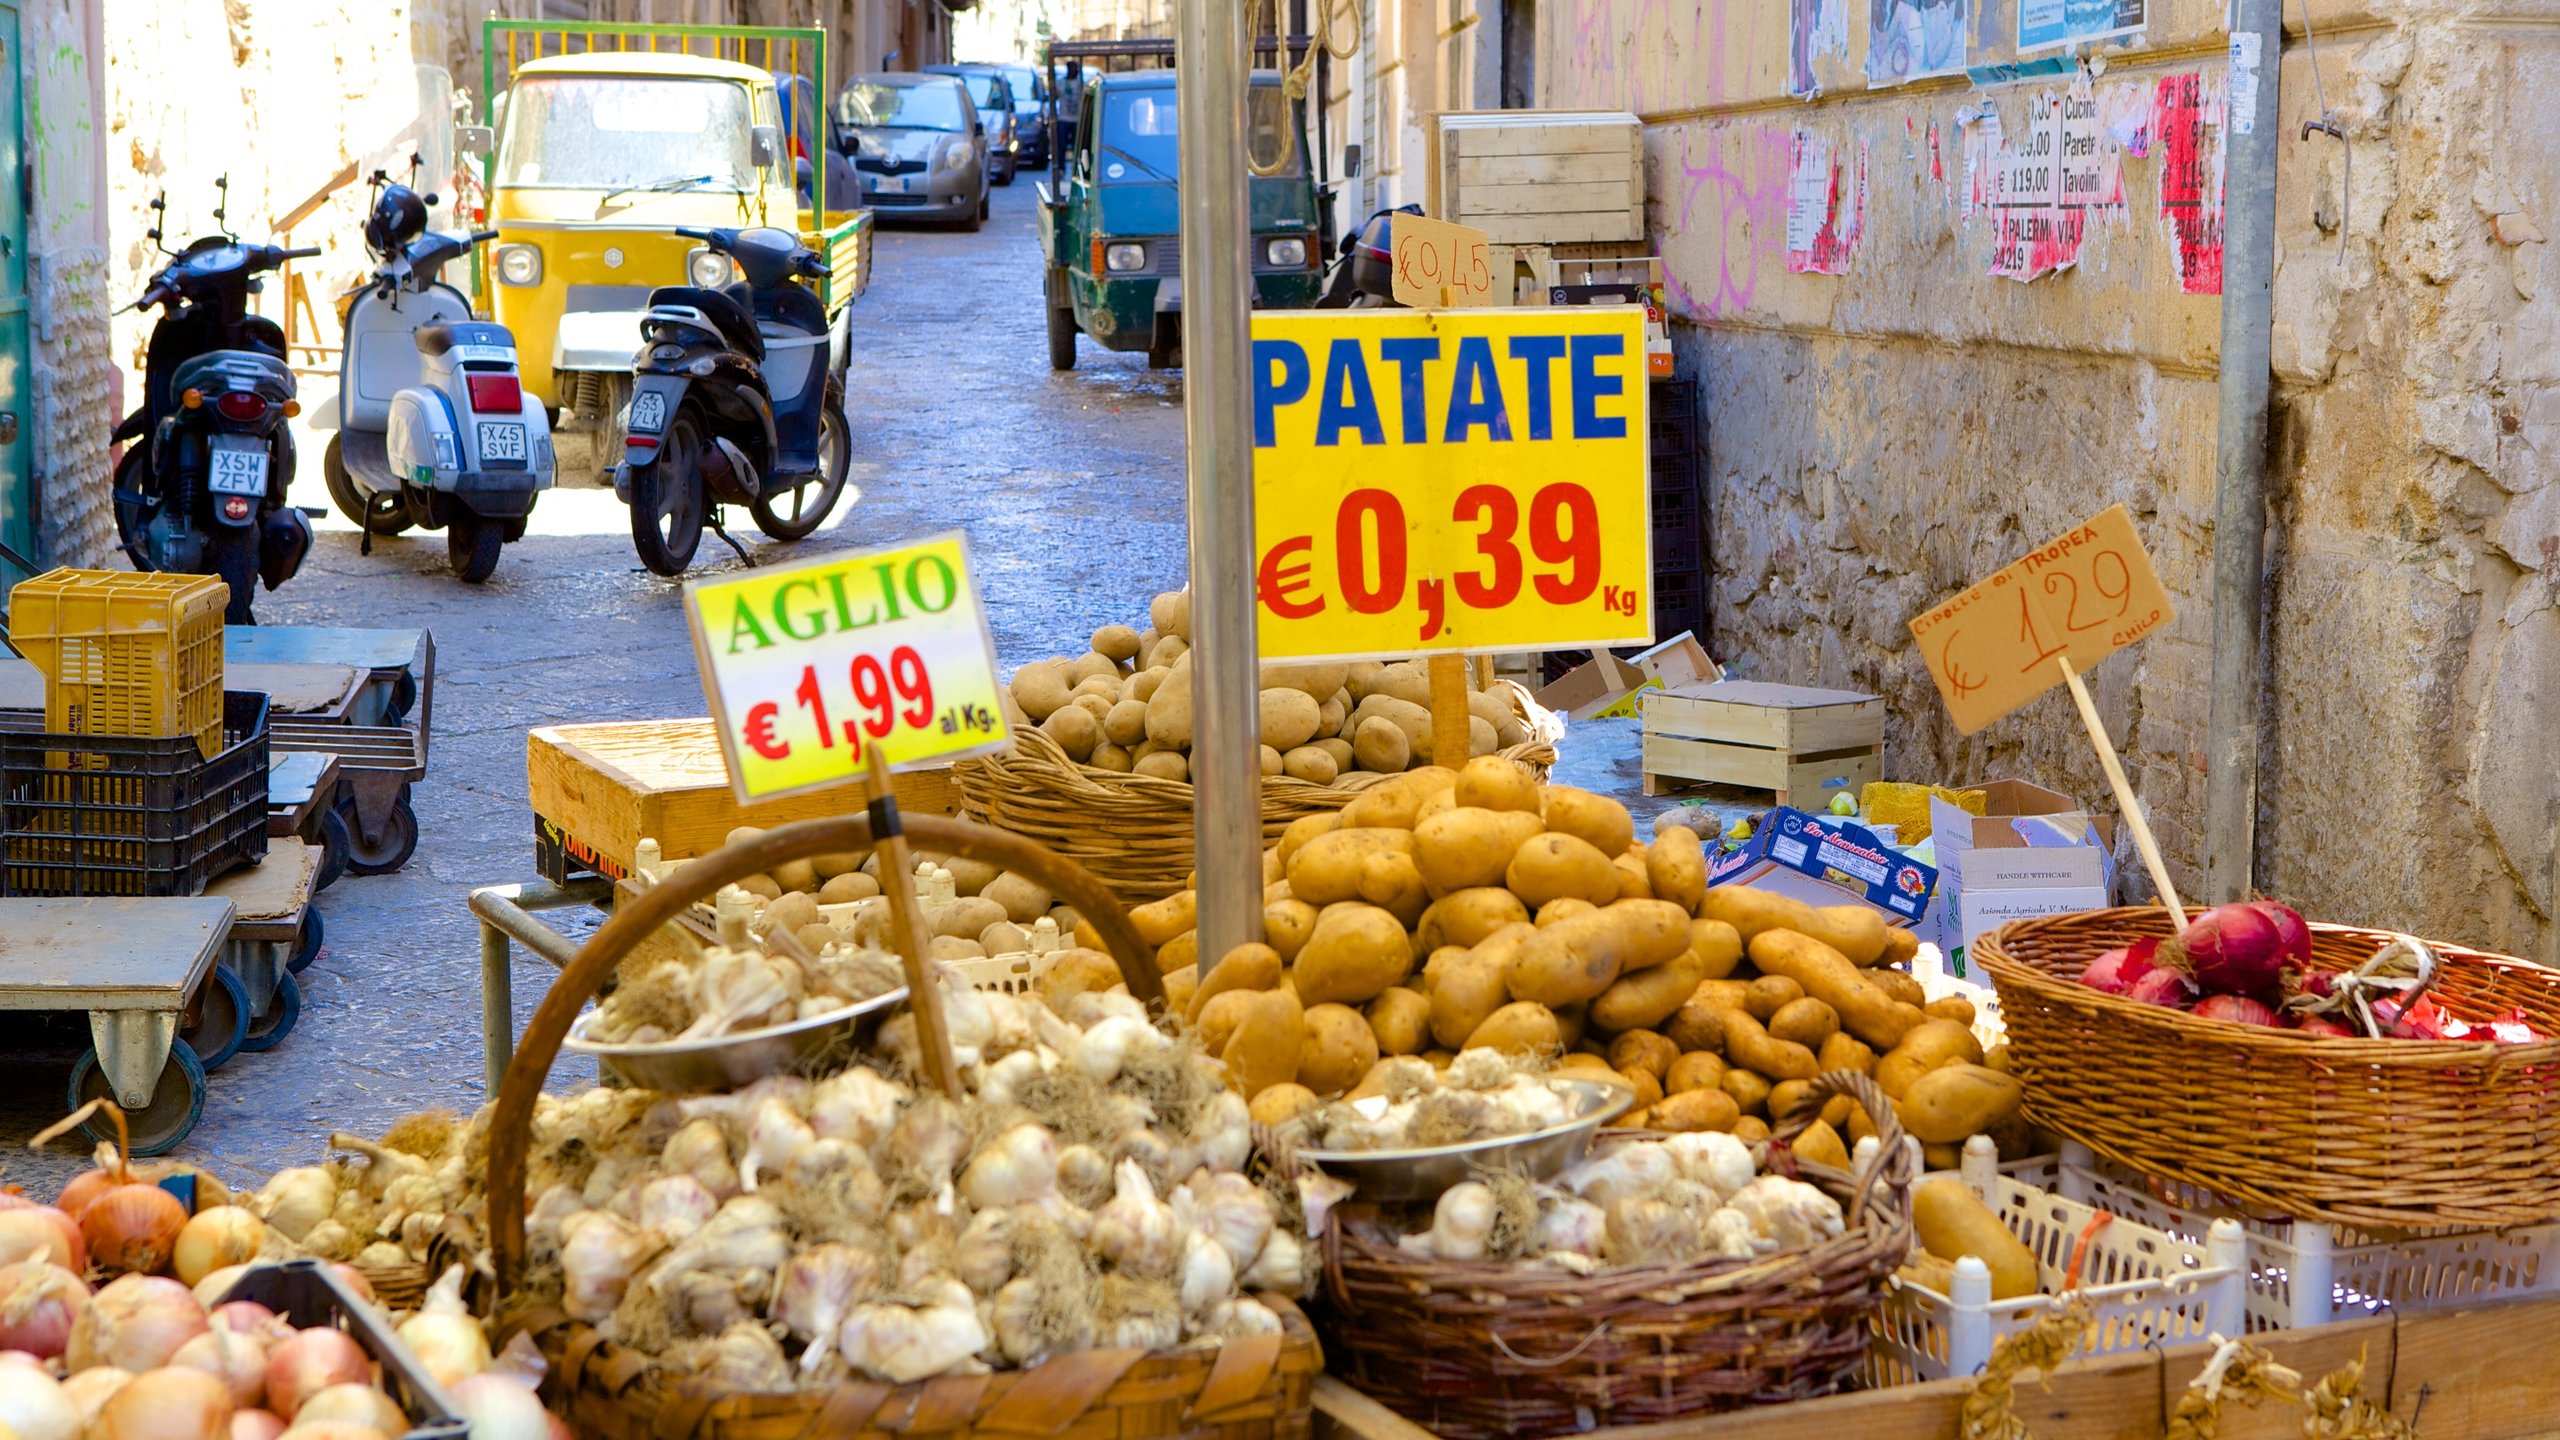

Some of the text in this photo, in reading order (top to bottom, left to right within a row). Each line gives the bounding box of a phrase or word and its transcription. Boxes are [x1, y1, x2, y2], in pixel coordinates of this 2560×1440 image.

[2012, 166, 2049, 196] 119,00
[1252, 334, 1628, 449] PATATE
[487, 426, 519, 441] X45
[219, 452, 261, 473] X5W
[488, 443, 519, 458] SVF
[217, 471, 259, 492] ZFV
[2019, 526, 2098, 575] TROPEA
[726, 553, 958, 655] AGLIO
[1603, 585, 1637, 617] Kg
[940, 708, 958, 736] al
[1997, 872, 2029, 880] HANDLE
[1979, 904, 2012, 916] Azienda
[2013, 903, 2047, 915] Agricola
